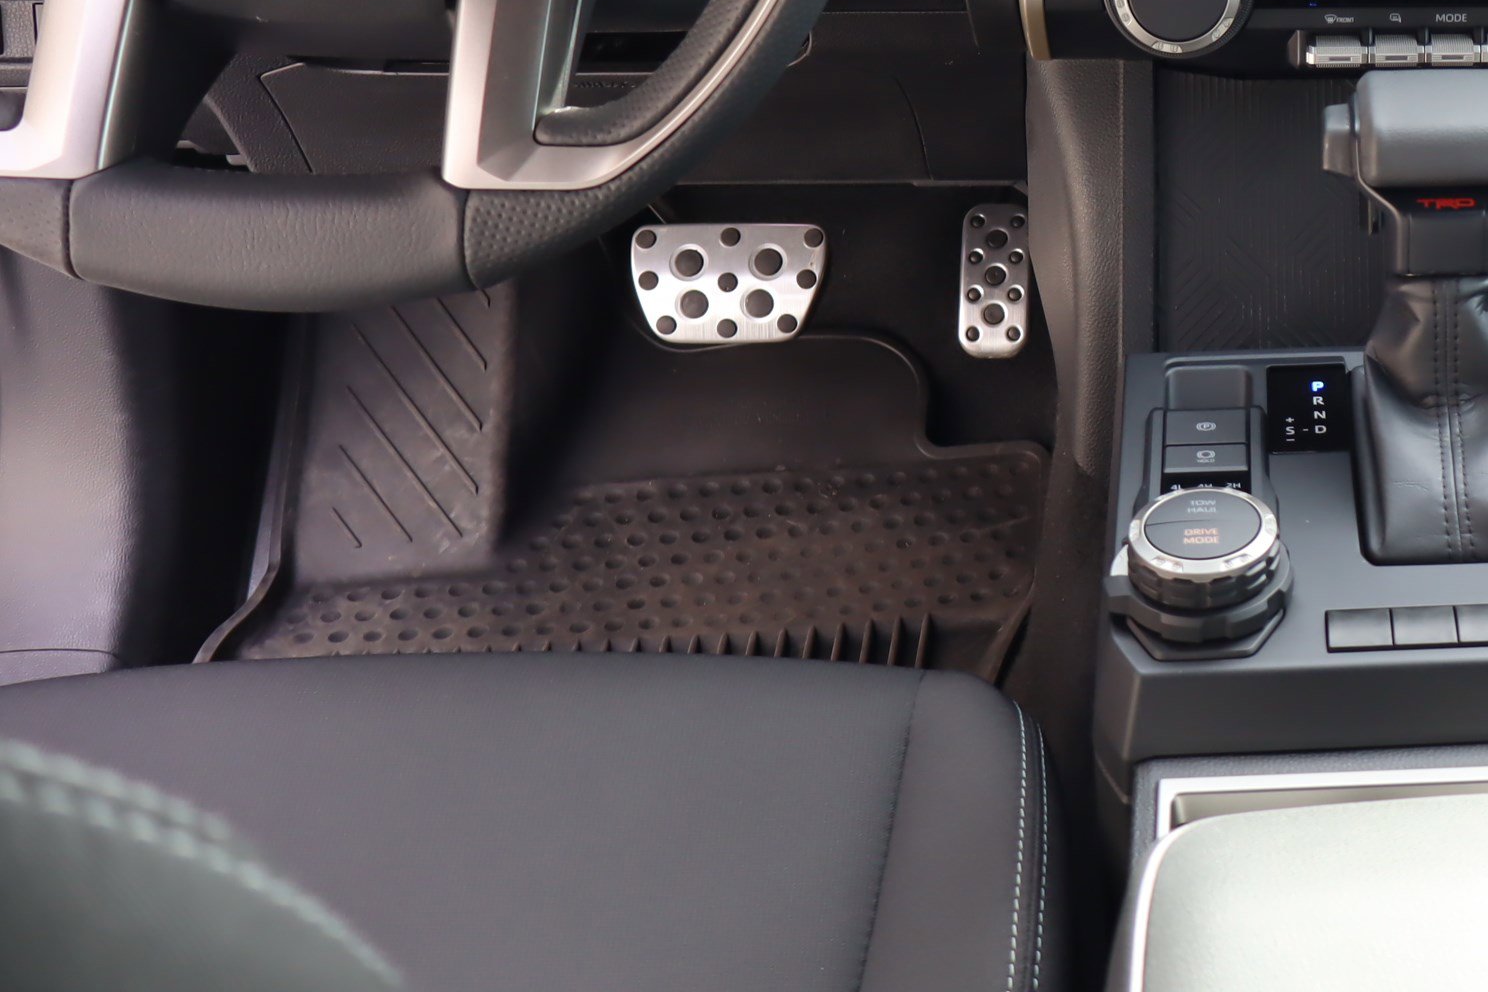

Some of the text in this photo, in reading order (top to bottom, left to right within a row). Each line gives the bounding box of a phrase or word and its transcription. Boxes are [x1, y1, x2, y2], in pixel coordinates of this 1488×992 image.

[1435, 13, 1467, 23] MODE
[1416, 197, 1477, 211] TRD
[1311, 380, 1325, 392] P
[1312, 396, 1324, 405] R
[1313, 410, 1326, 419] N
[1285, 425, 1327, 435] S D
[1184, 527, 1219, 536] DRIVE
[1183, 536, 1219, 545] MODE
